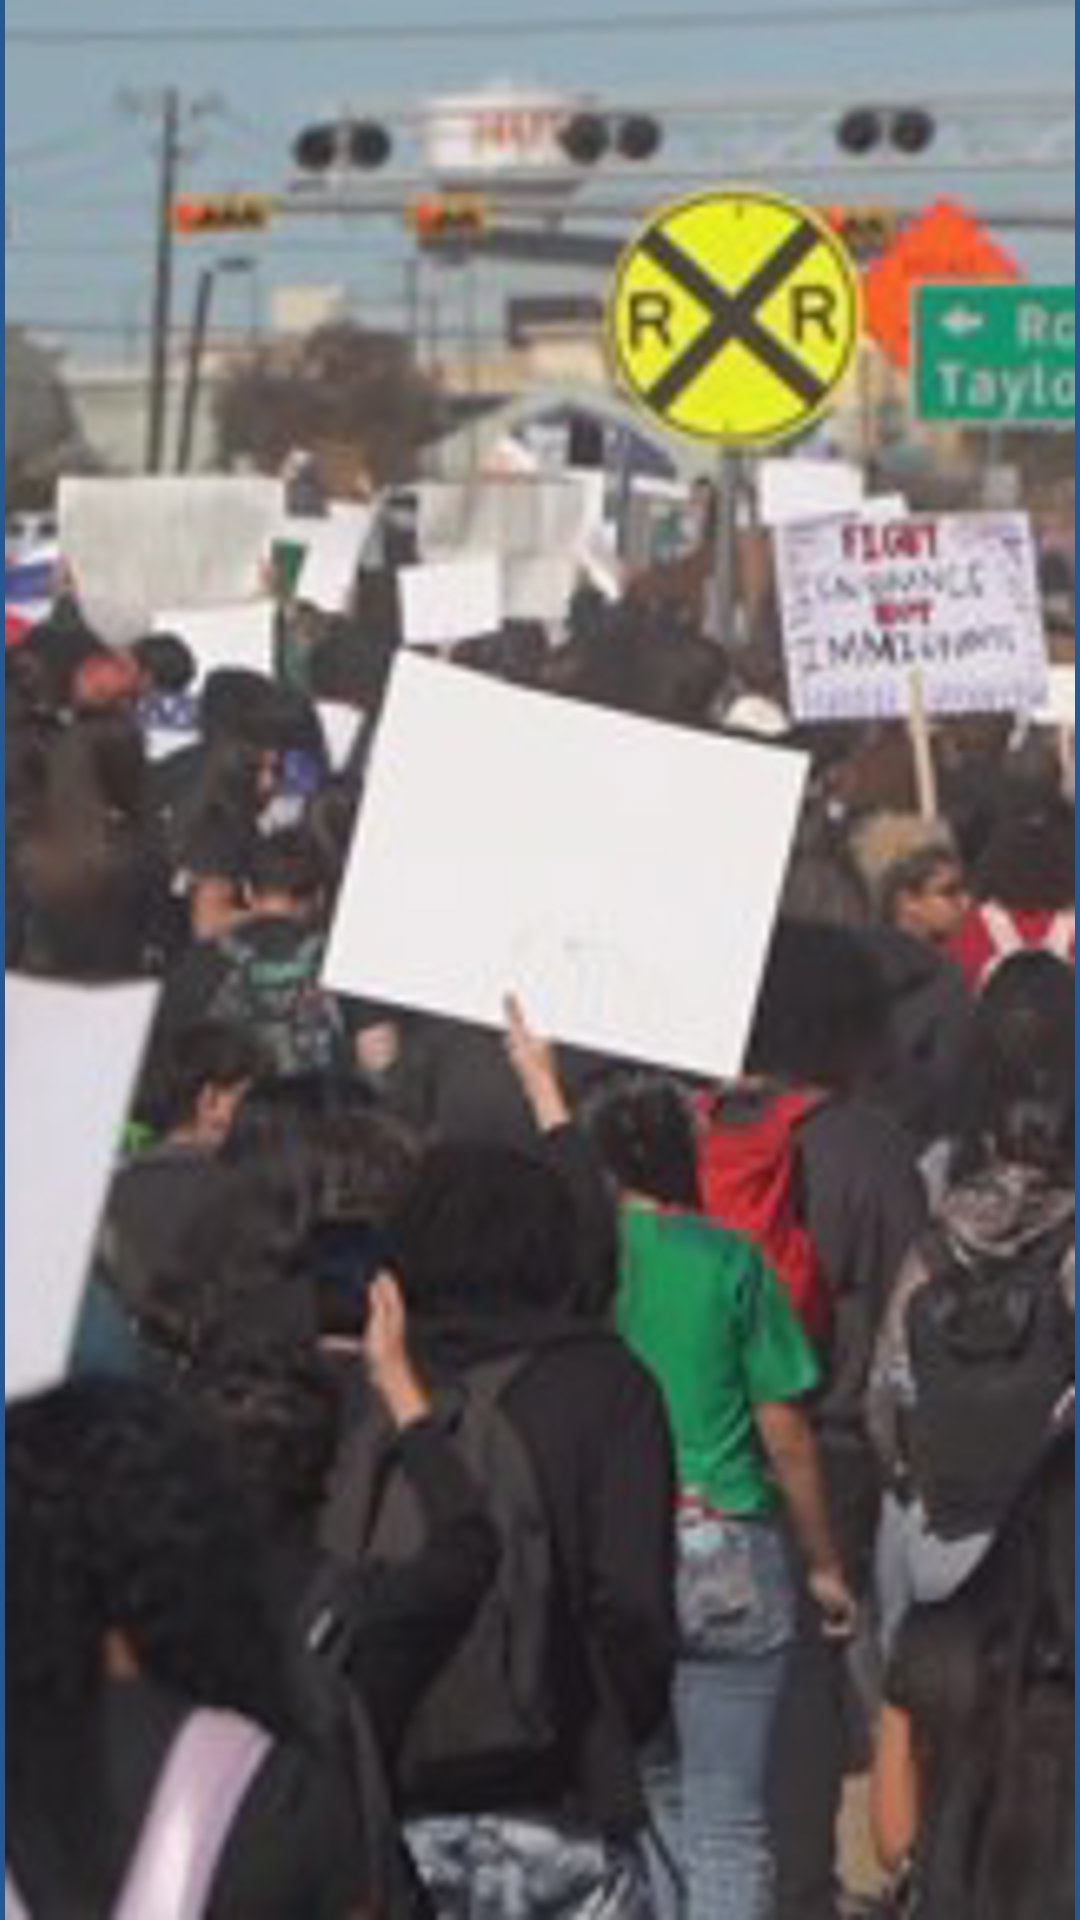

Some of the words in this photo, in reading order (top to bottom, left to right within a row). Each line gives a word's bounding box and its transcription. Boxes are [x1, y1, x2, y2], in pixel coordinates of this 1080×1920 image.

[629, 291, 673, 349] R
[791, 285, 837, 343] R
[935, 360, 1075, 421] Taylo
